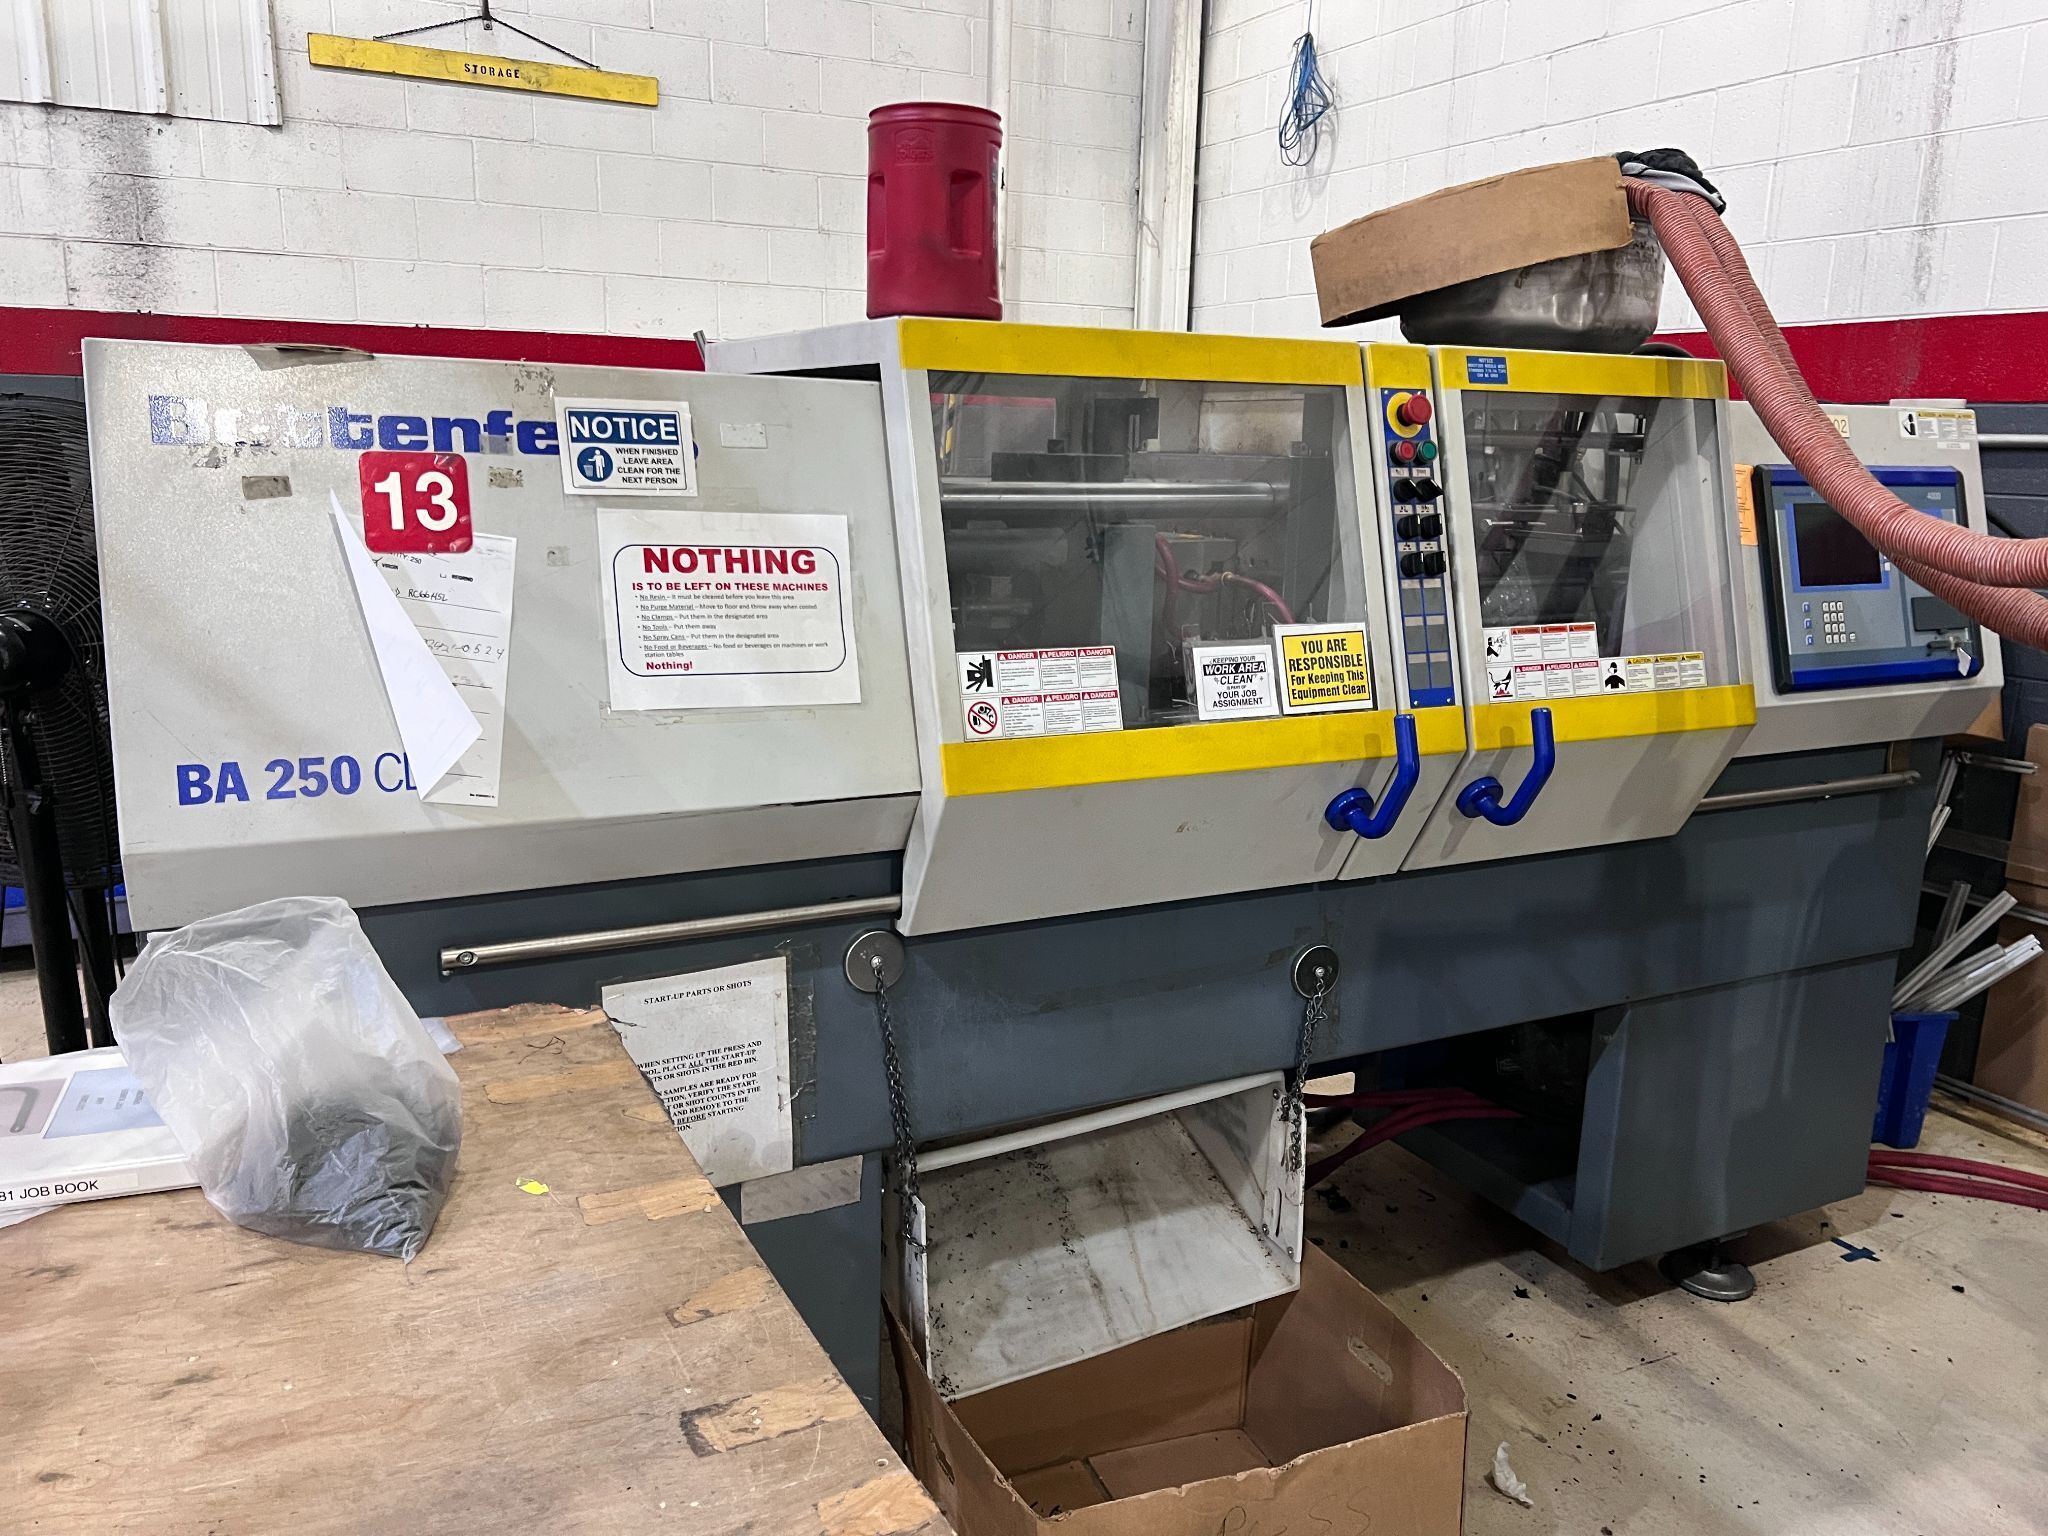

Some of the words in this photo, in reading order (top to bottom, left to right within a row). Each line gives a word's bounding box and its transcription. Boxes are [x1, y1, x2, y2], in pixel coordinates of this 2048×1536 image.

[464, 63, 520, 80] STORAGE
[570, 416, 677, 440] NOTICE
[642, 448, 678, 456] FINISHED
[647, 467, 663, 475] FOR
[375, 470, 458, 532] 13
[643, 548, 816, 574] NOTHING
[735, 583, 769, 591] THESE
[773, 583, 828, 591] MACHINES
[1301, 641, 1323, 654] YOU
[1326, 638, 1347, 652] ARE
[1008, 652, 1034, 660] DANGER
[1289, 653, 1363, 672] RESPONSIBLE
[646, 661, 693, 670] Nothing!
[1204, 664, 1235, 675] WORK
[1239, 662, 1266, 672] AREA
[1220, 675, 1253, 685] CLEAN
[1291, 674, 1305, 686] For
[1308, 672, 1344, 685] Keeping
[1346, 670, 1364, 681] This
[1217, 690, 1239, 699] YOUR
[1292, 687, 1340, 701] Equipment
[1342, 683, 1366, 695] Clean
[1213, 697, 1263, 708] ASSIGNMENT
[177, 761, 250, 806] BA
[264, 755, 361, 800] 250
[644, 992, 684, 1005] START-UP
[686, 988, 711, 998] PARTS
[714, 985, 725, 993] OR
[726, 980, 752, 990] SHOTS
[638, 1060, 660, 1069] WHEN
[662, 1053, 693, 1064] SETTING
[724, 1044, 745, 1053] PRESS
[662, 1064, 686, 1073] PLACE
[688, 1061, 703, 1069] ALL
[705, 1057, 720, 1065] THE
[721, 1049, 757, 1060] START-UP
[676, 1068, 700, 1078] SHOTS
[711, 1063, 726, 1071] THE
[728, 1059, 742, 1067] RED
[664, 1083, 698, 1096] SAMPLES
[716, 1075, 741, 1085] READY
[742, 1072, 757, 1080] FOR
[688, 1088, 714, 1098] VERIFY
[717, 1084, 731, 1093] THE
[673, 1102, 684, 1110] OR
[685, 1098, 705, 1107] SHOT
[706, 1091, 736, 1103] COUNTS
[746, 1086, 761, 1094] THE
[673, 1109, 688, 1117] AND
[689, 1103, 721, 1114] REMOVE
[734, 1096, 749, 1104] THE
[677, 1113, 706, 1125] BEFORE
[708, 1106, 744, 1117] STARTING
[20, 1186, 50, 1199] JOB
[54, 1180, 99, 1195] BOOK
